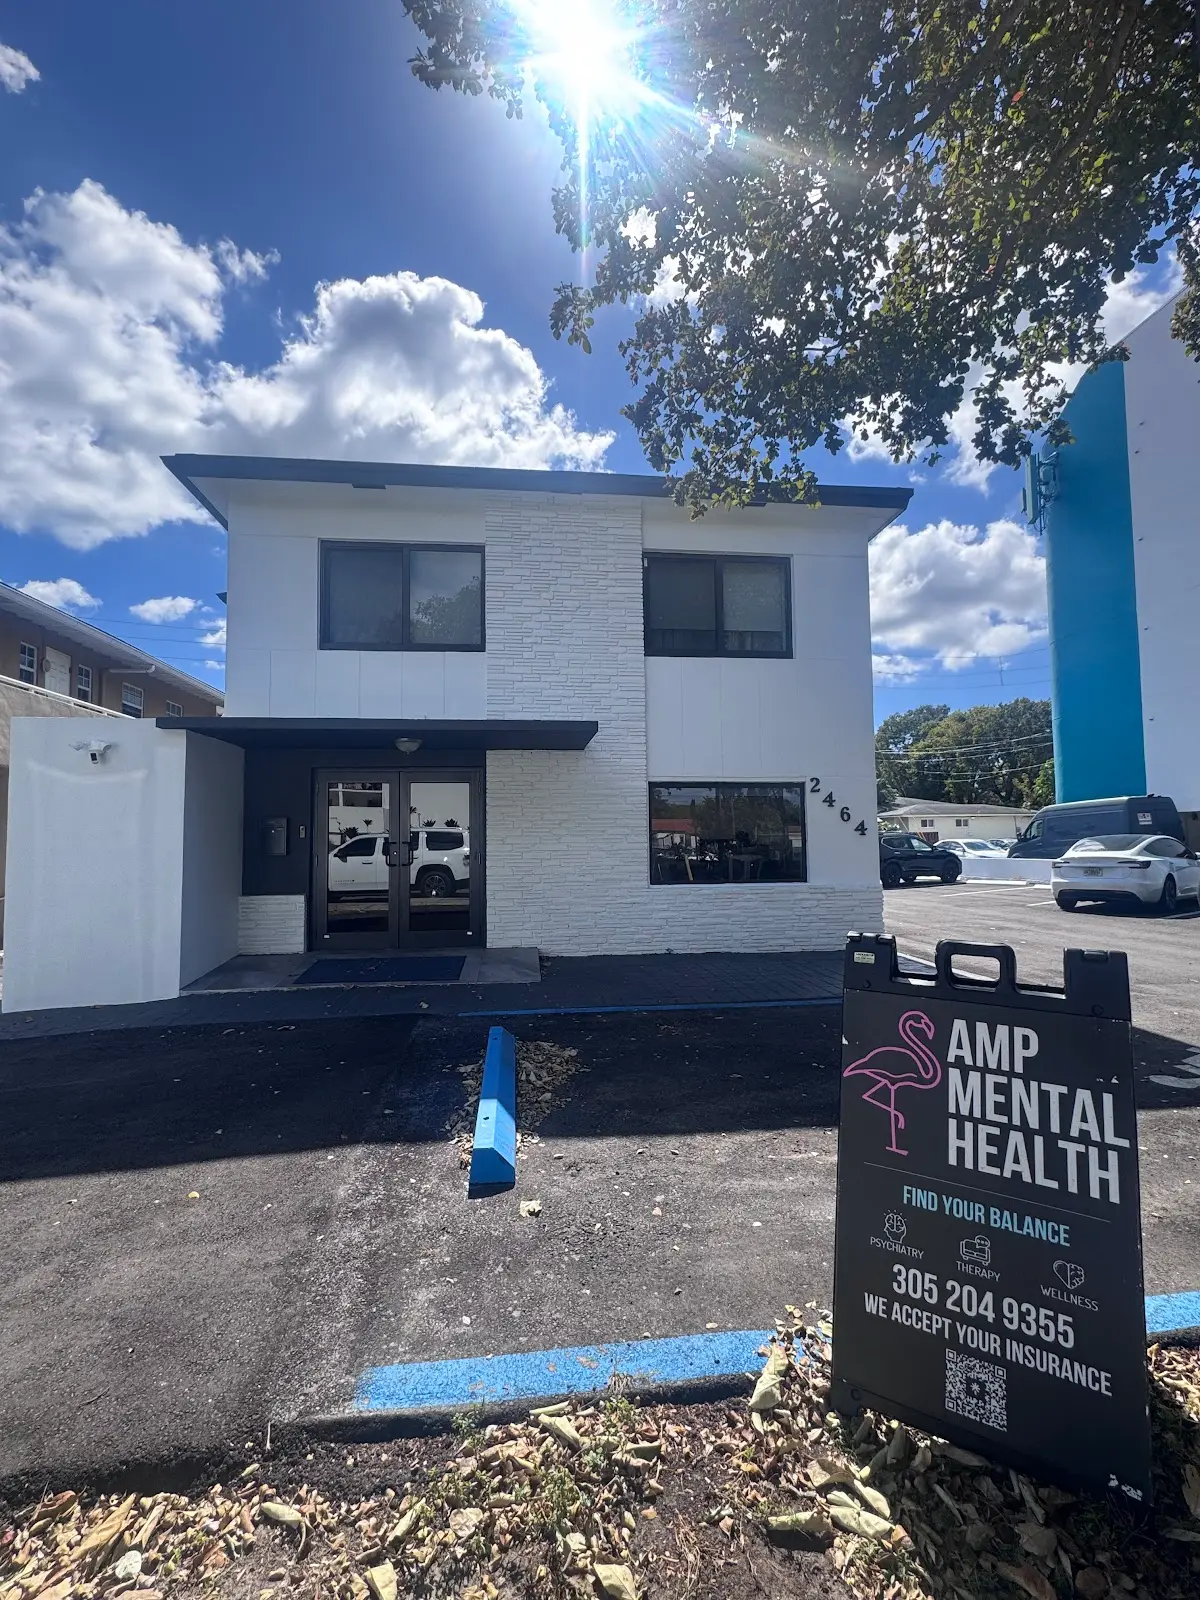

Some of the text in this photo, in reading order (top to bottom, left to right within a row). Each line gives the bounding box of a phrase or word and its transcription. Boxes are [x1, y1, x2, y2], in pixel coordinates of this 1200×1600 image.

[809, 777, 867, 835] 2464
[946, 1018, 1039, 1074] AMP
[948, 1066, 1131, 1148] MENTAL
[948, 1117, 1121, 1205] HEALTH
[903, 1185, 1071, 1247] FIND YOUR BALANCE
[870, 1236, 925, 1260] PSYCHIATRY
[956, 1260, 1001, 1283] THERAPY
[892, 1263, 1075, 1349] 305 204 9355
[1040, 1284, 1099, 1312] WELLNESS
[864, 1292, 1113, 1397] WE ACCEPT YOUR INSURANCE
